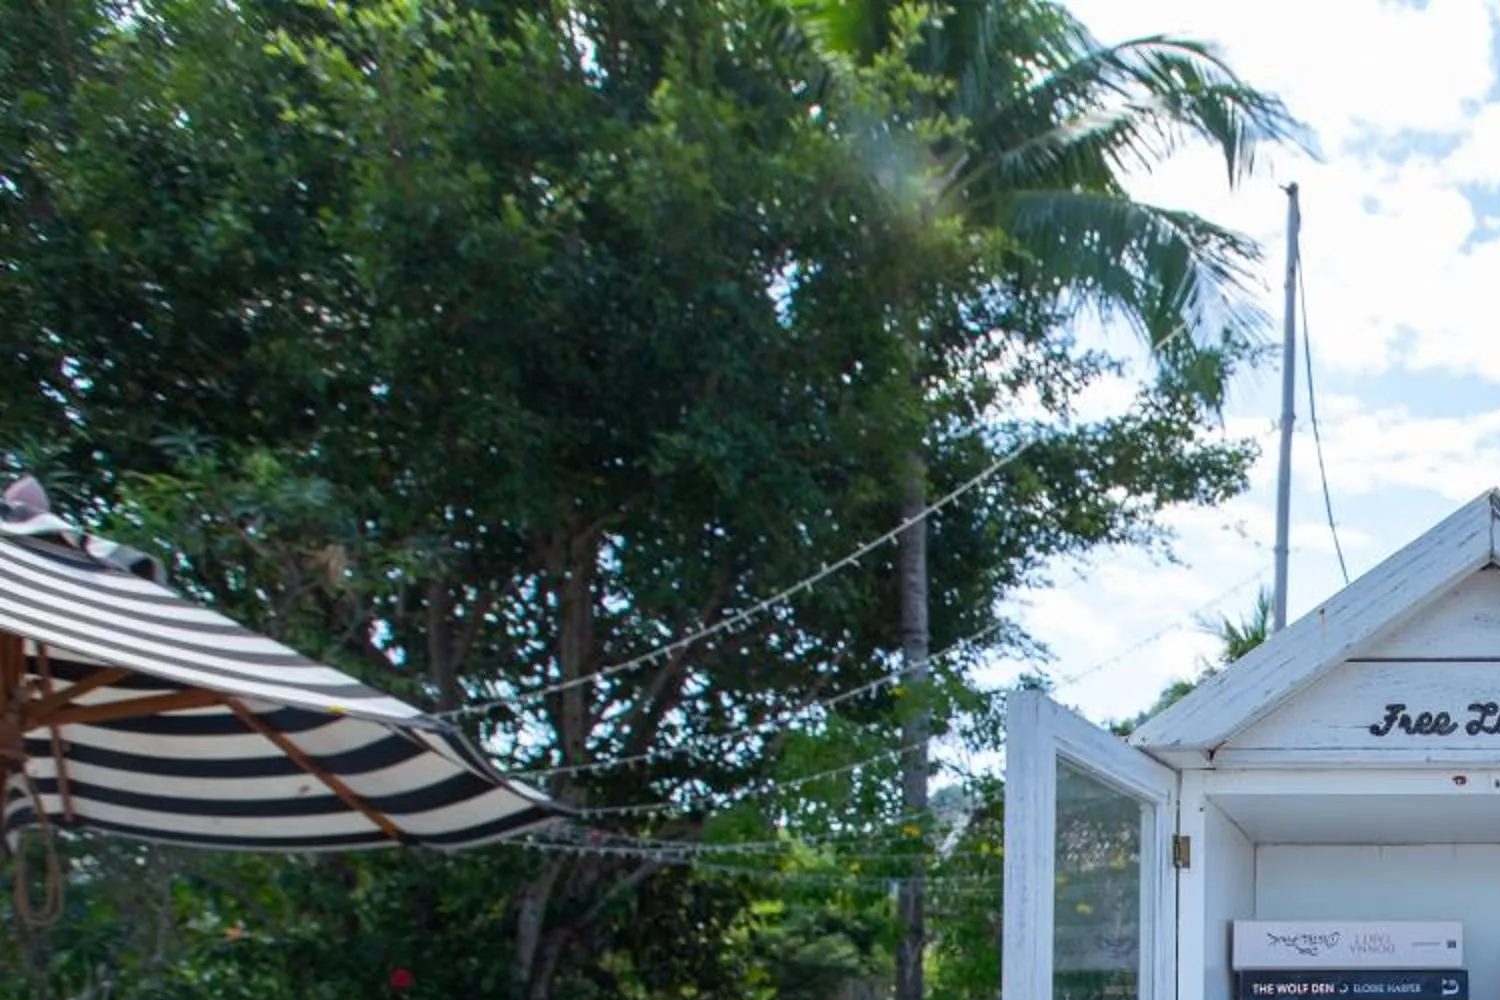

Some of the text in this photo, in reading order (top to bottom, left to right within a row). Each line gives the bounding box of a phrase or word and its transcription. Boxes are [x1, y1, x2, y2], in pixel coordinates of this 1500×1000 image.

[1369, 702, 1458, 736] Free
[1252, 983, 1274, 995] THE
[1276, 983, 1309, 995] WOLF
[1311, 983, 1335, 993] DEN
